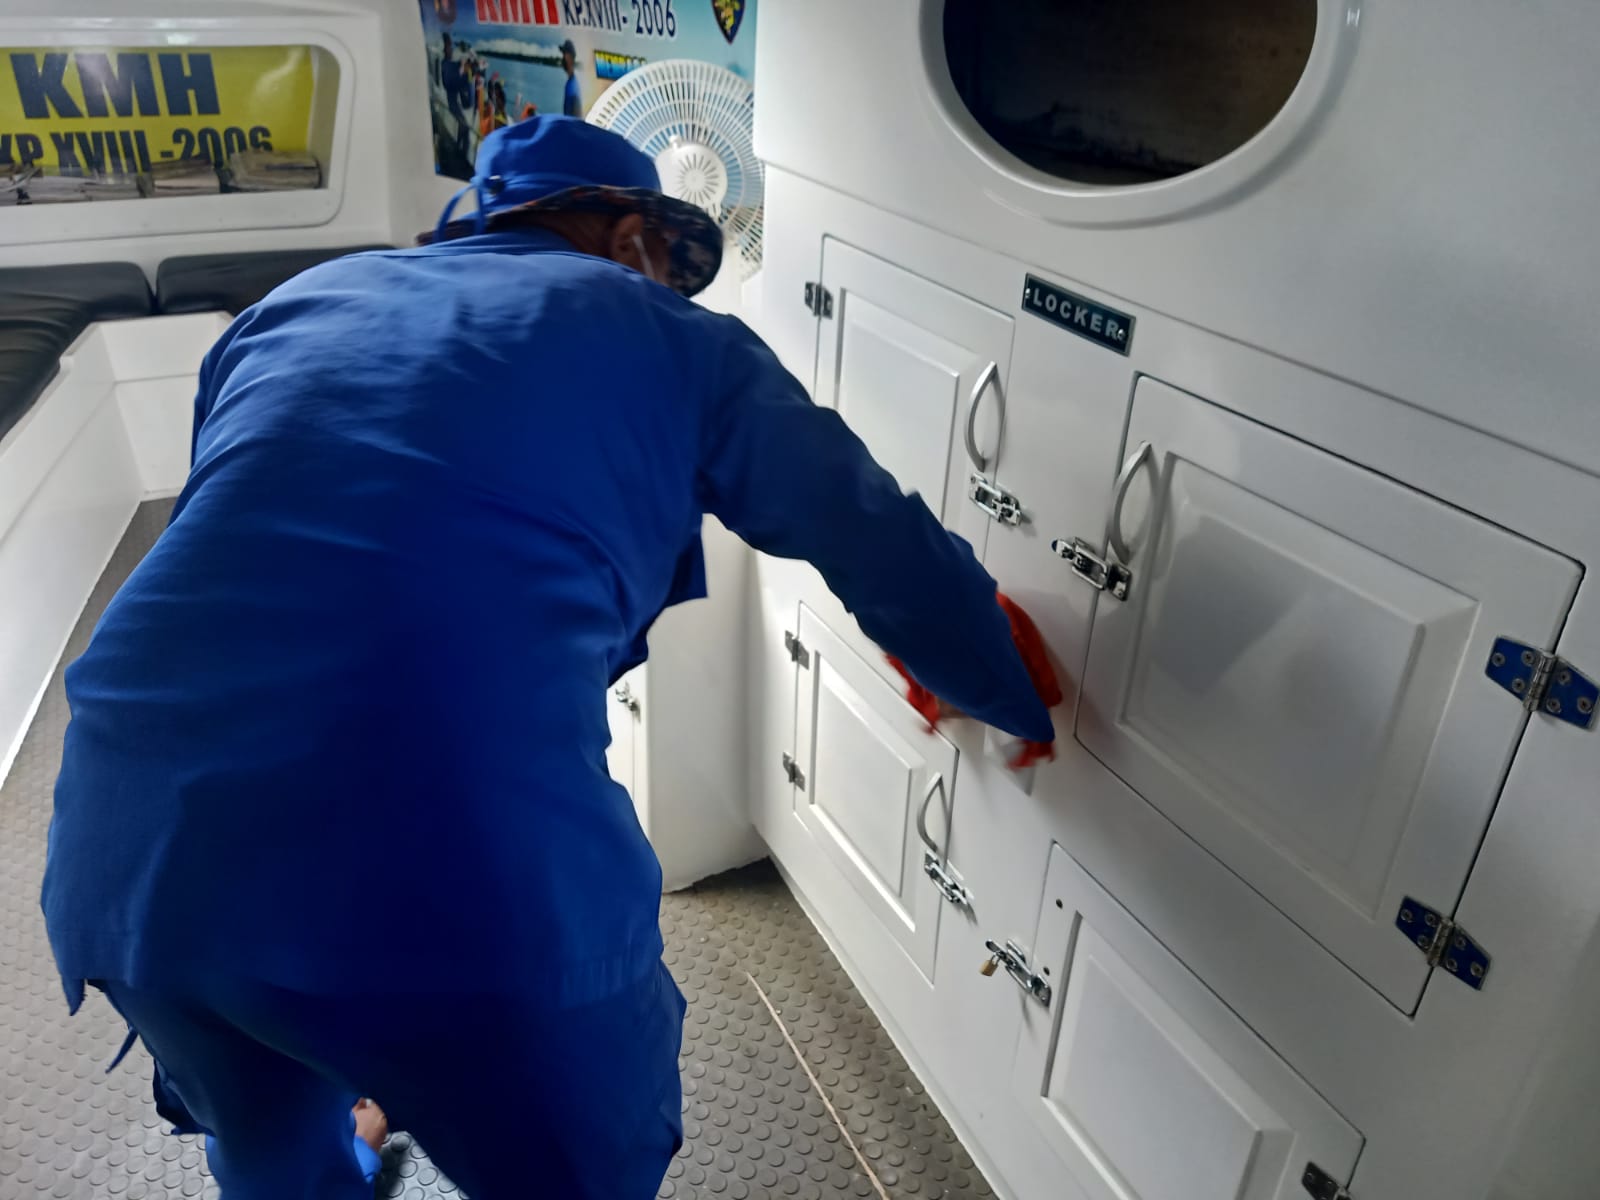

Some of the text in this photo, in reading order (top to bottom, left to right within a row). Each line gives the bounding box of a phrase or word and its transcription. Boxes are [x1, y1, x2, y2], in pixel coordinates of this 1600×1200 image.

[632, 0, 677, 38] 2006
[10, 52, 221, 119] KMH
[1032, 287, 1121, 340] LOCKER
